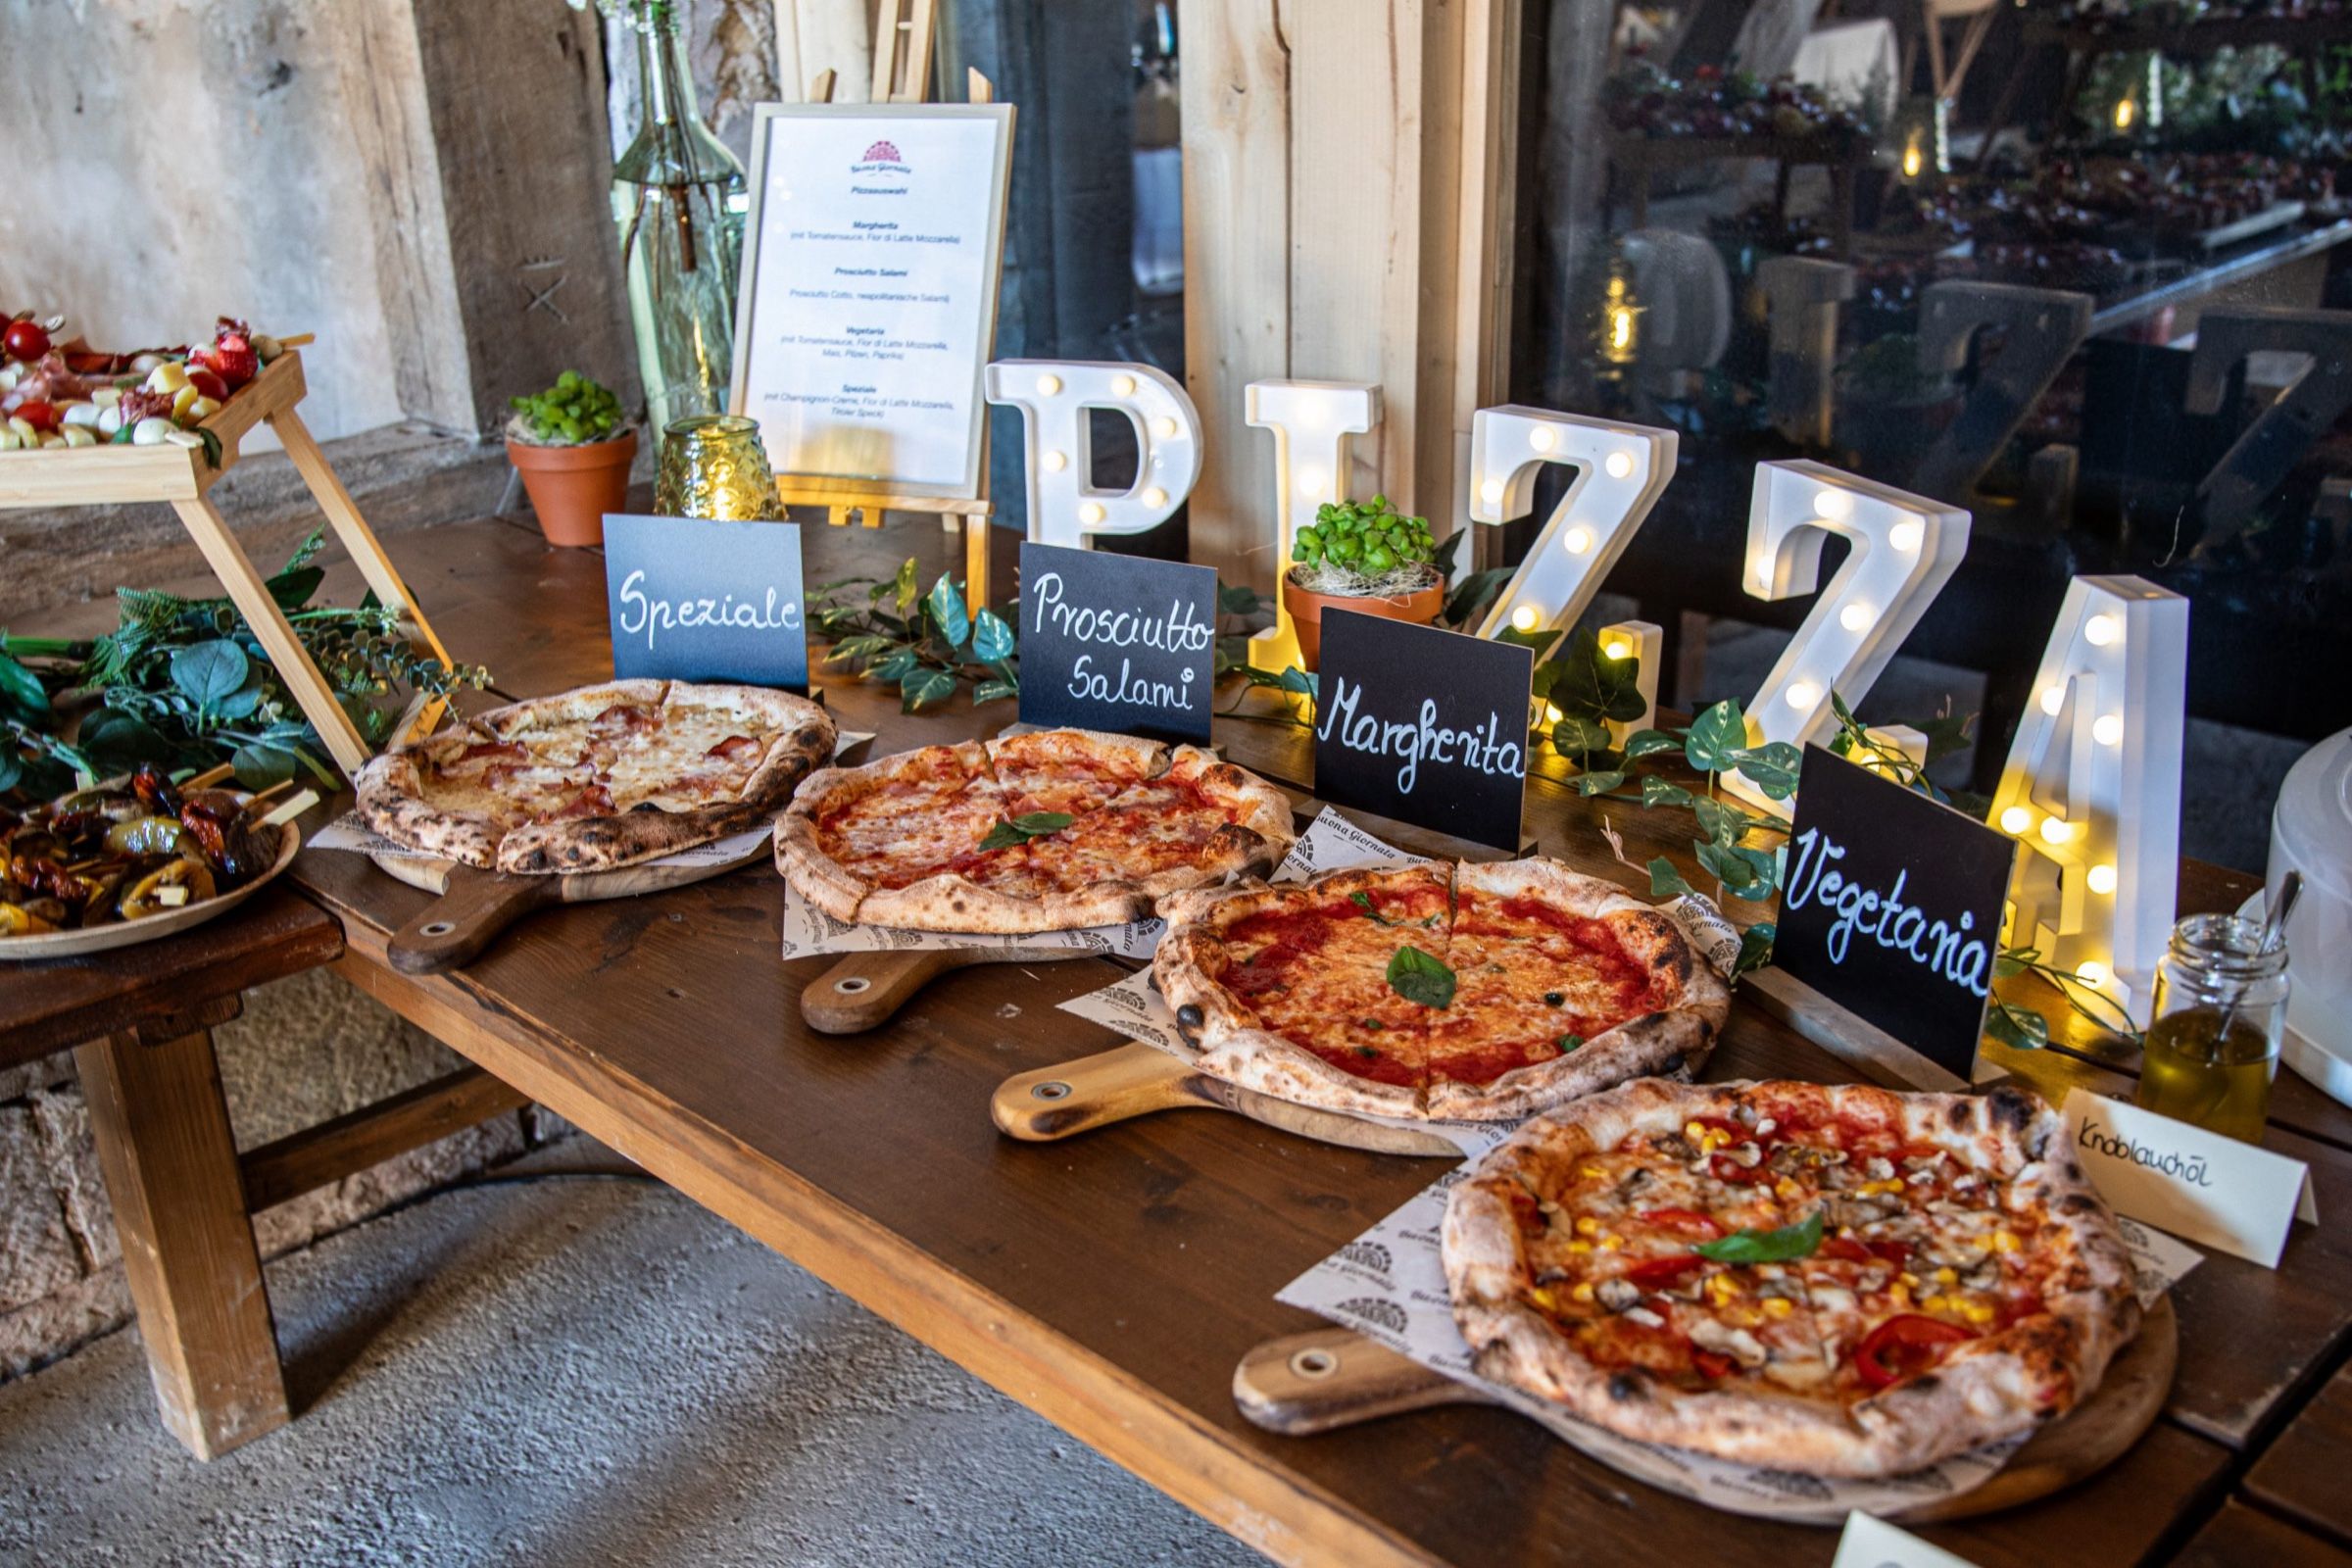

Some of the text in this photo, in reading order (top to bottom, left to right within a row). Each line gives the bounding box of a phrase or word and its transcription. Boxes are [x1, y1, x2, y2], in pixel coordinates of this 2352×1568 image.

[853, 221, 899, 230] Margherita
[866, 233, 882, 242] Fior
[894, 234, 913, 243] Latte
[834, 267, 908, 277] Prosciutto Salami
[846, 325, 885, 336] Vegetaria
[858, 338, 872, 347] Fior
[883, 339, 904, 349] Latte
[843, 384, 877, 394] Speziale
[889, 398, 909, 408] Latte
[619, 569, 801, 651] Speziale
[1033, 571, 1215, 654] Prosciutto
[1067, 655, 1195, 710] Salami
[985, 359, 2190, 1034] PIZZA
[1317, 676, 1526, 794] Margherita
[1349, 829, 1396, 859] Giornata
[1786, 826, 1988, 998] Vegetaria
